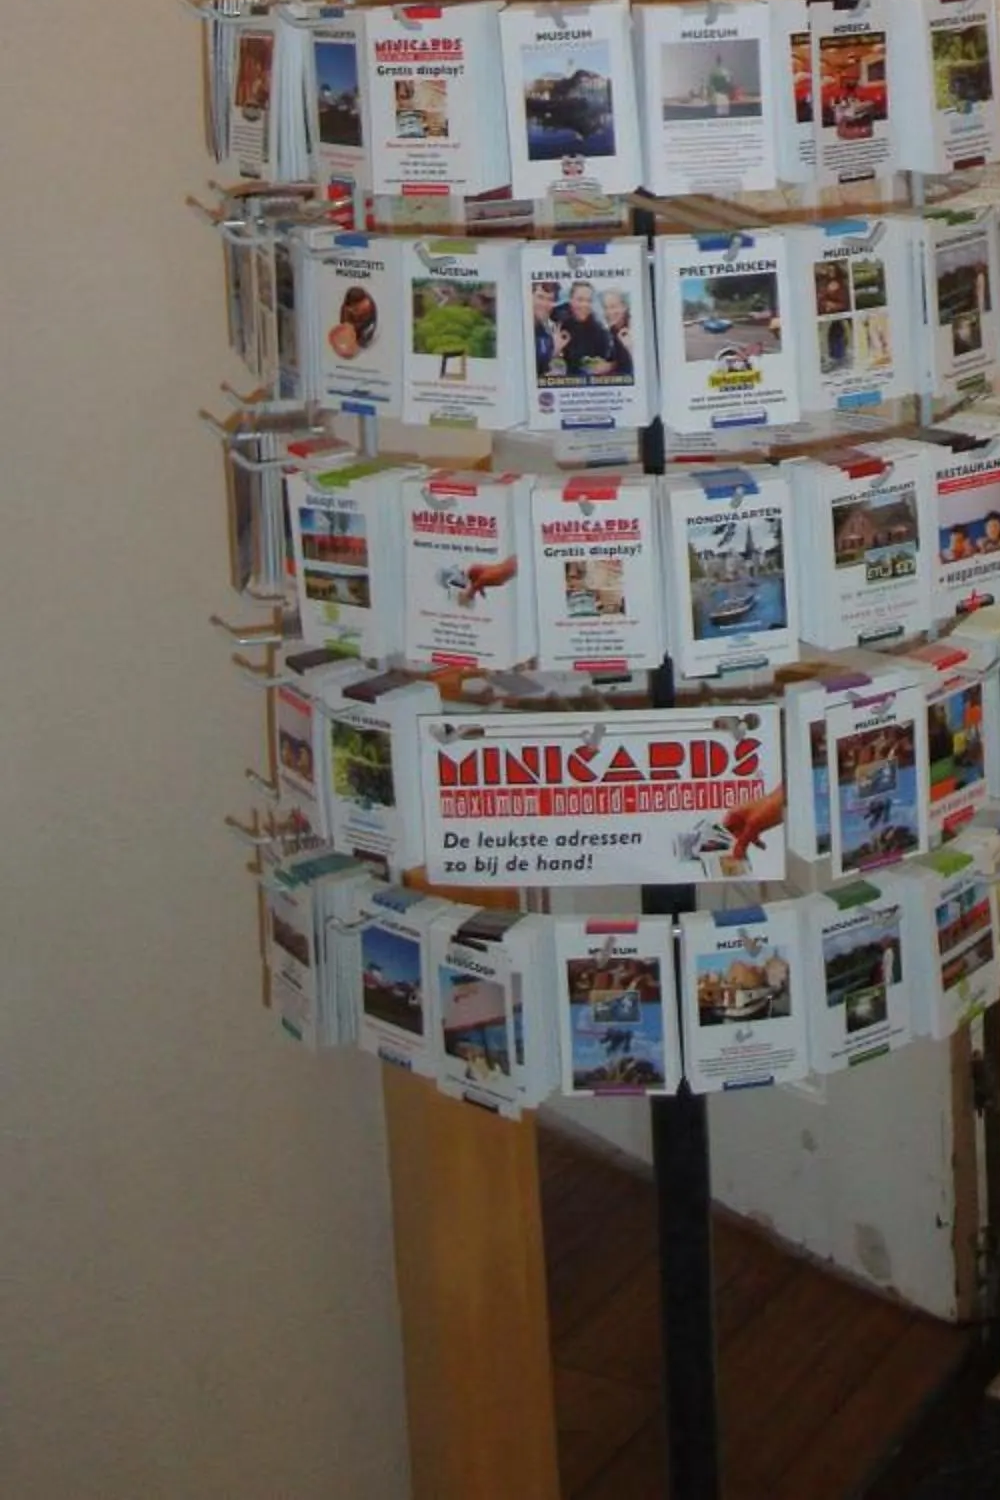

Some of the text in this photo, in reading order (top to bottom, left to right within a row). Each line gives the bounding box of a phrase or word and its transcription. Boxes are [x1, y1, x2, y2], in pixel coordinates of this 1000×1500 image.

[535, 28, 593, 42] MUSEUM
[681, 27, 739, 40] MUSEUM
[429, 266, 480, 278] MUSEUM
[531, 271, 572, 281] LEREN
[679, 259, 778, 278] PRETPARKEN
[686, 506, 783, 526] RONDVAARTEN
[544, 546, 586, 558] Gratis
[438, 736, 763, 787] MINICARDS
[441, 792, 539, 818] maximum
[444, 828, 641, 849] De leukste adressen
[445, 853, 593, 876] zo bij de hand!
